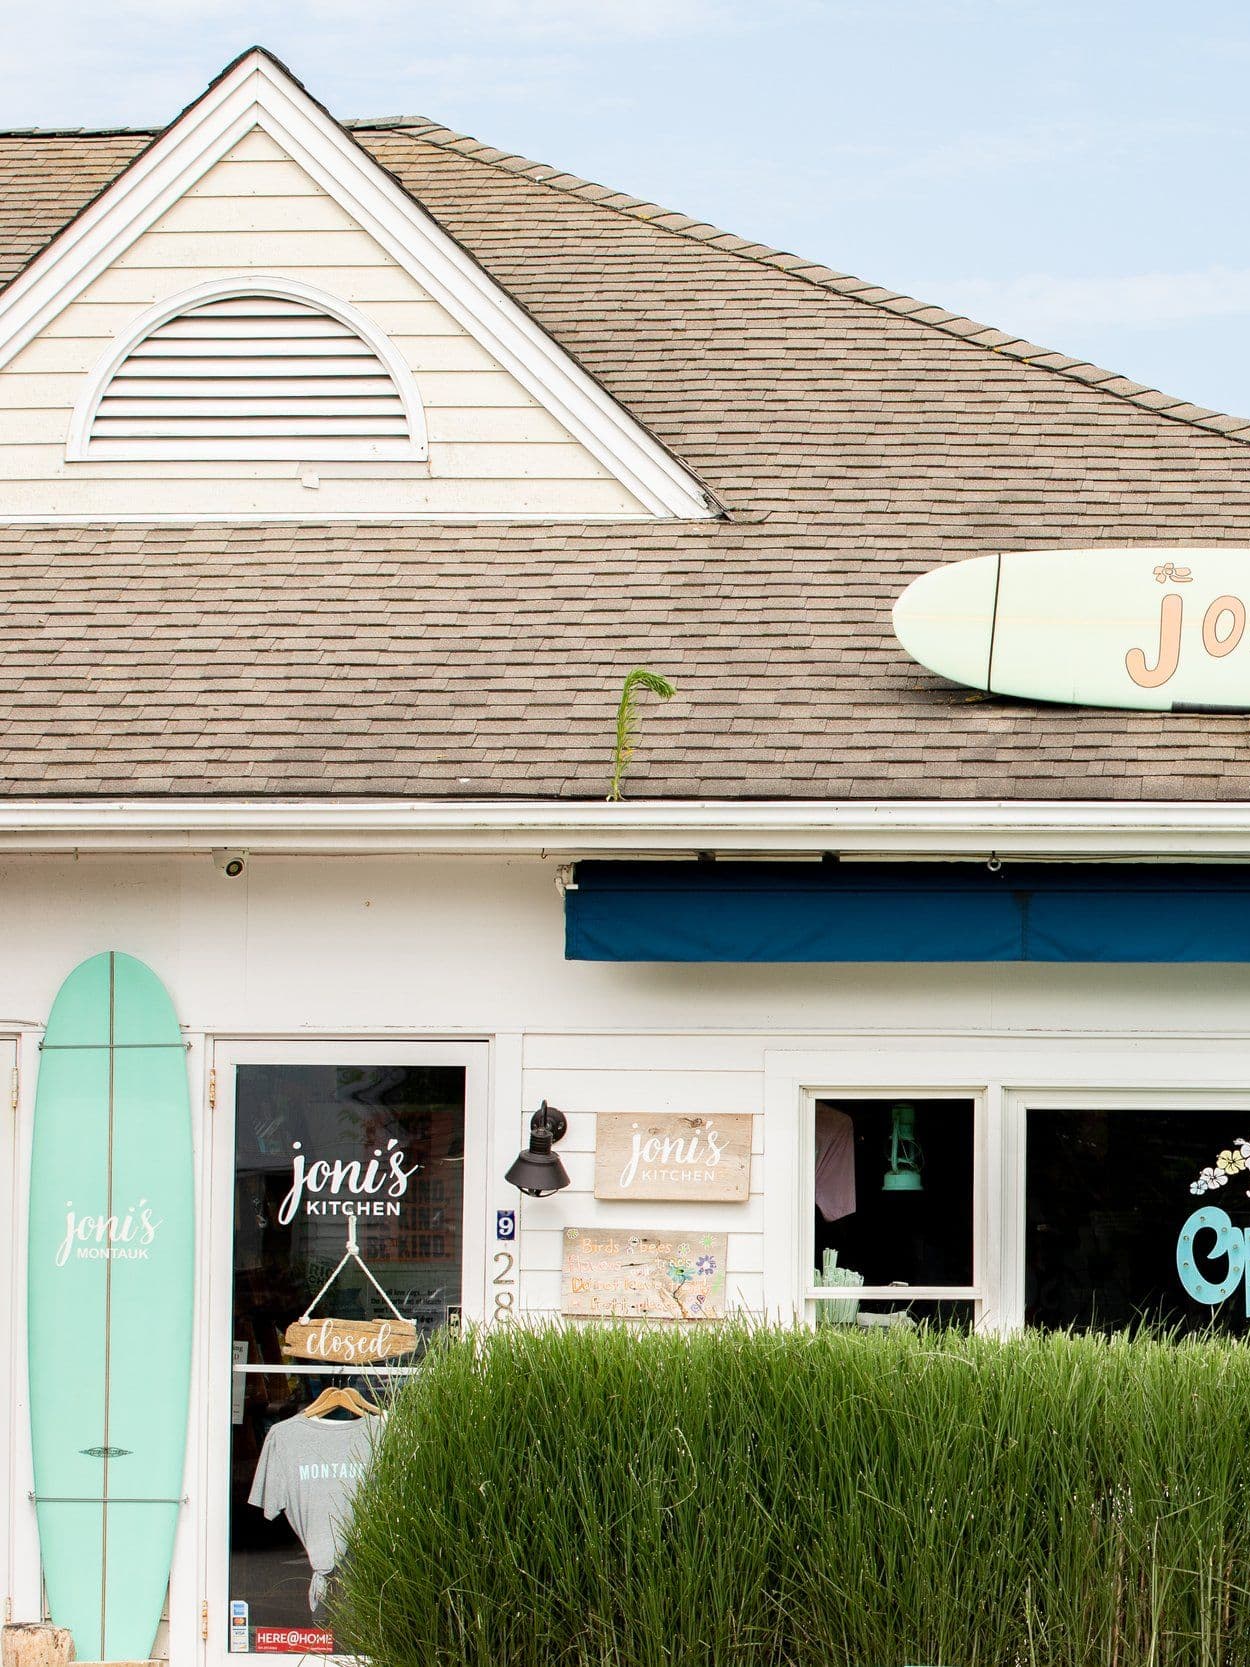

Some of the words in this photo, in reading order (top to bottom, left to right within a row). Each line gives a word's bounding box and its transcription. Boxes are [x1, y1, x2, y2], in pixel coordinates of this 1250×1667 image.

[619, 1120, 730, 1188] joni's
[278, 1138, 419, 1225] joni's
[642, 1170, 715, 1182] KITCHEN
[306, 1201, 401, 1216] KITCHEN
[55, 1198, 165, 1267] joni's
[580, 1238, 620, 1255] Birds
[639, 1239, 674, 1254] bees
[77, 1247, 149, 1259] MONTAUK
[306, 1320, 393, 1361] closed
